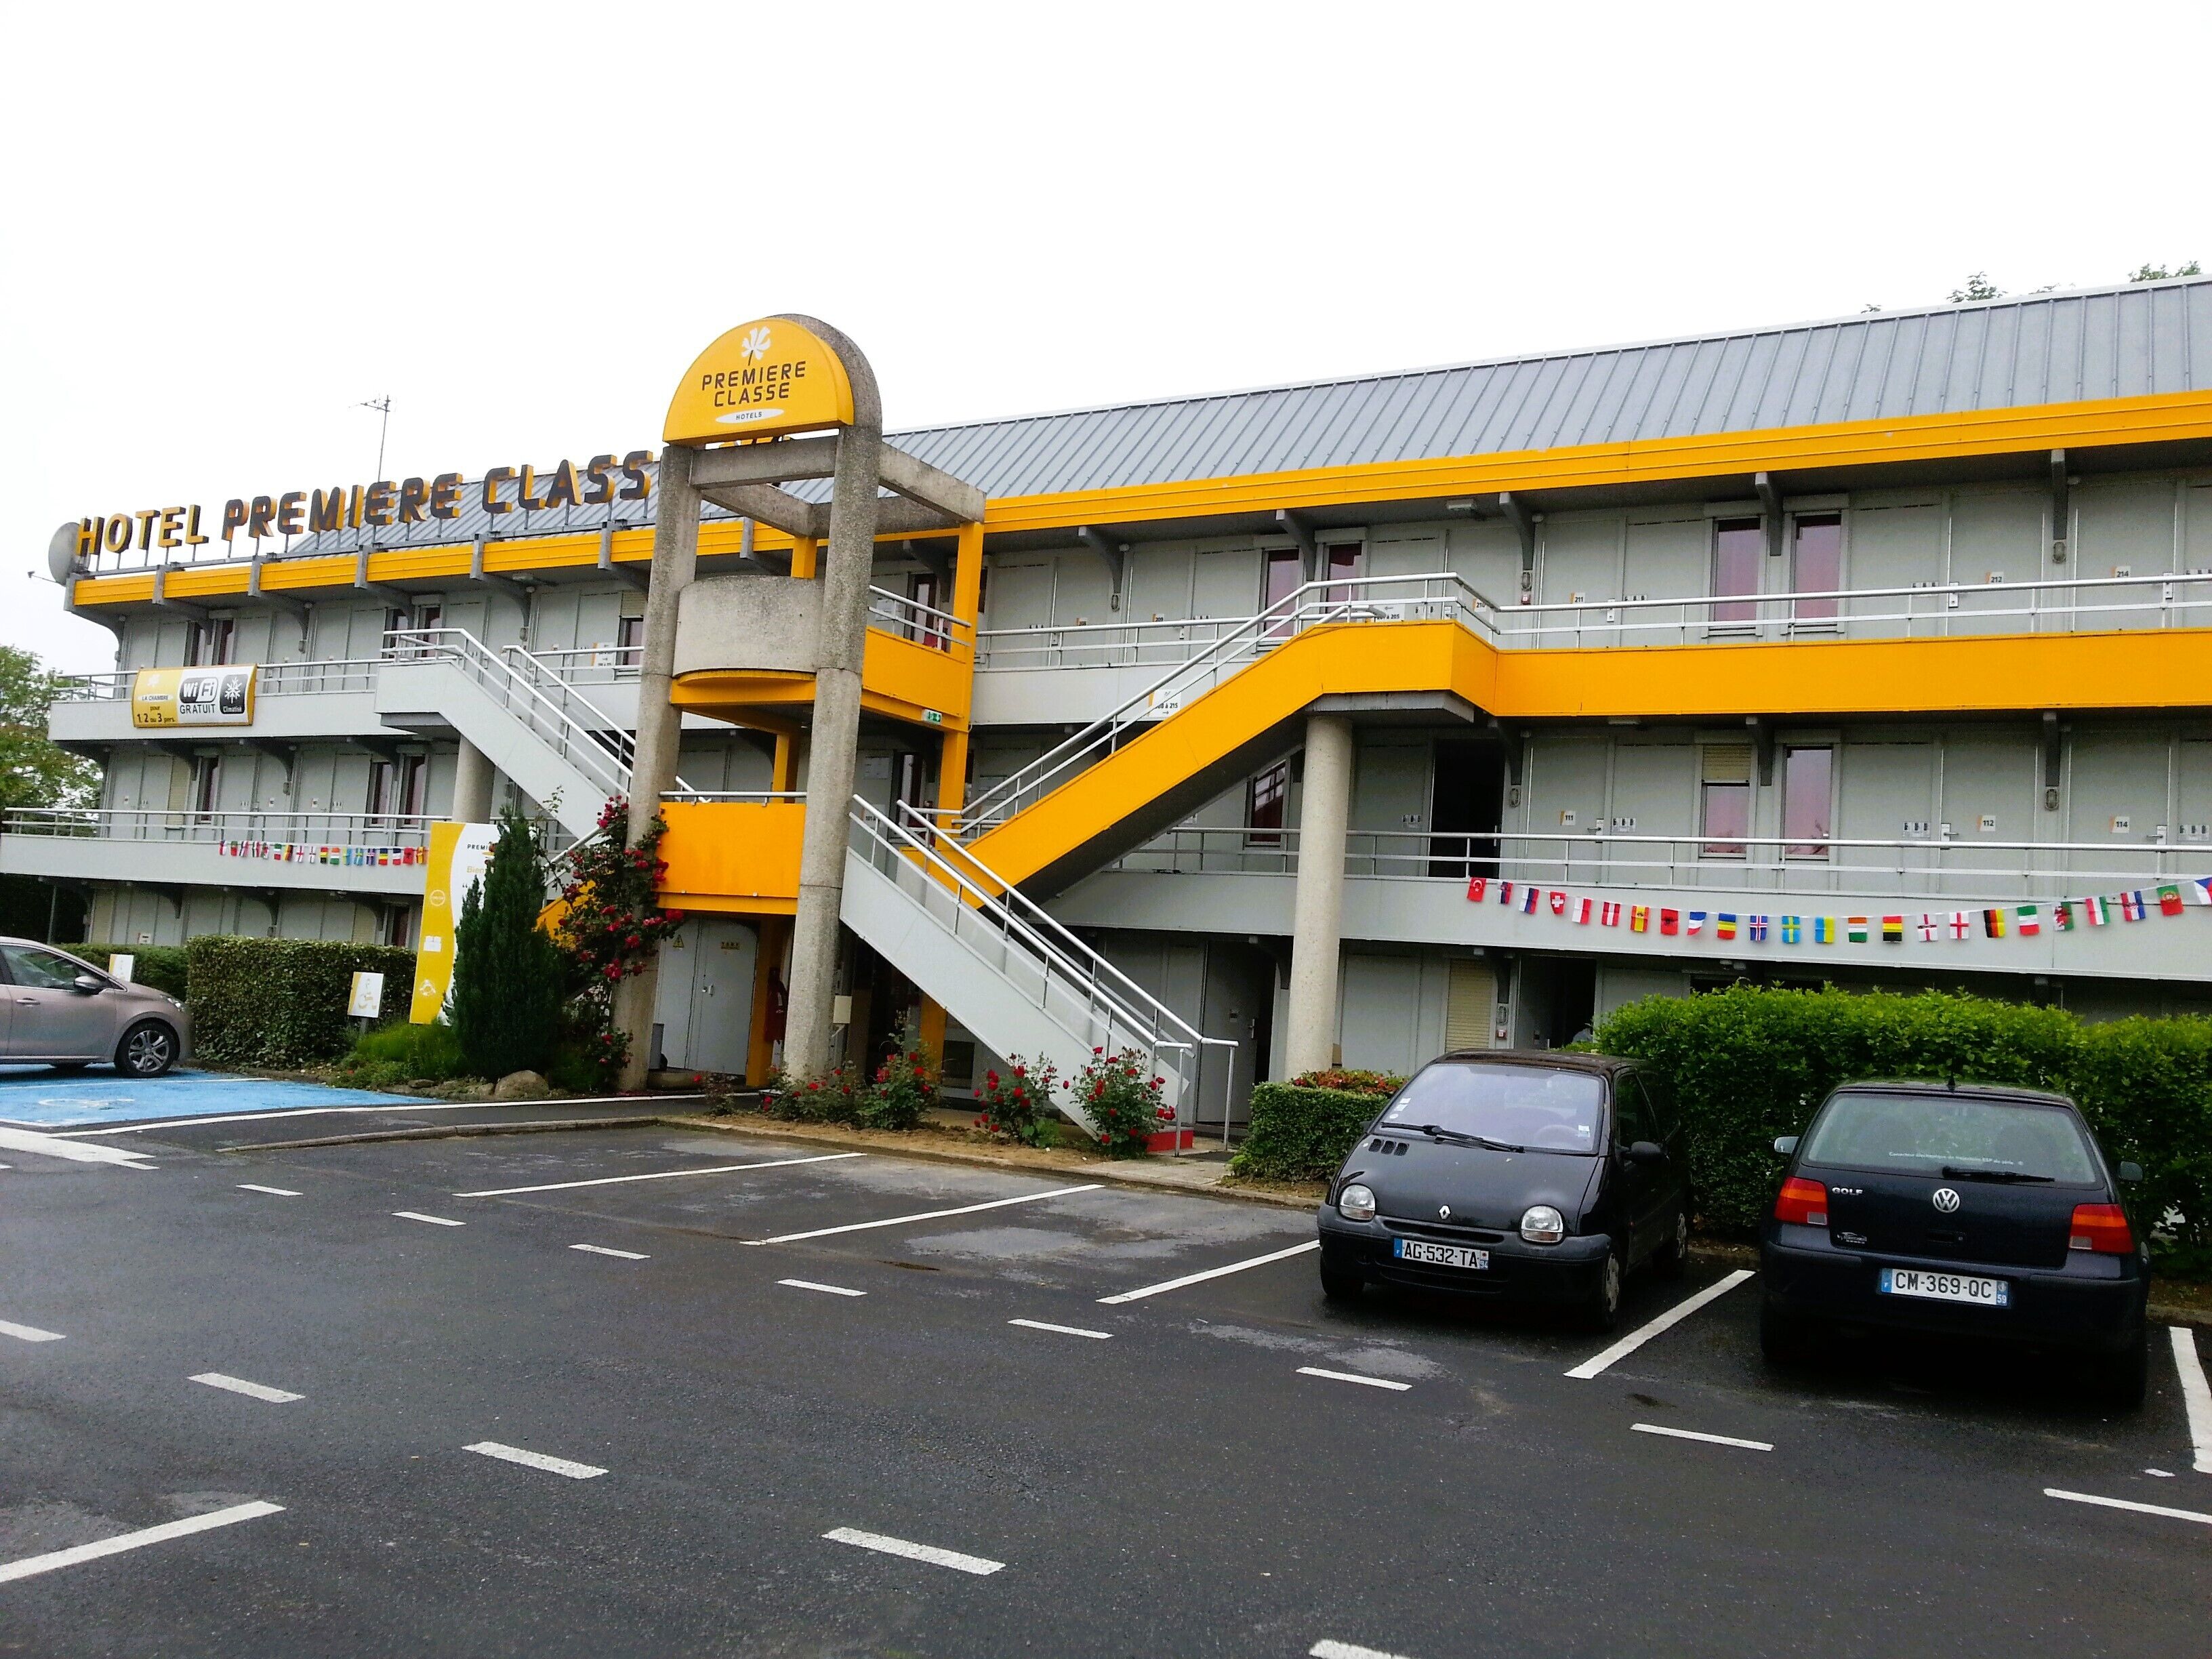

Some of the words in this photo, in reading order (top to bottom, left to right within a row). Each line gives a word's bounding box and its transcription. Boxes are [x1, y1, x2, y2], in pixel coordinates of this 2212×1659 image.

[701, 361, 806, 390] PREMIERE
[714, 382, 790, 407] CLASSE
[736, 411, 762, 420] HOTELS
[75, 504, 209, 557] HOTEL
[222, 472, 463, 541] PREMIERE
[482, 449, 656, 514] CLASS
[157, 712, 162, 722] 3
[180, 703, 216, 714] GRATUIT
[466, 865, 485, 874] Bien
[1832, 1187, 1864, 1195] GOLF
[1404, 1242, 1478, 1268] AG-532-TA
[1896, 1271, 1992, 1298] CM-369-QC
[1996, 1294, 2007, 1304] 59
